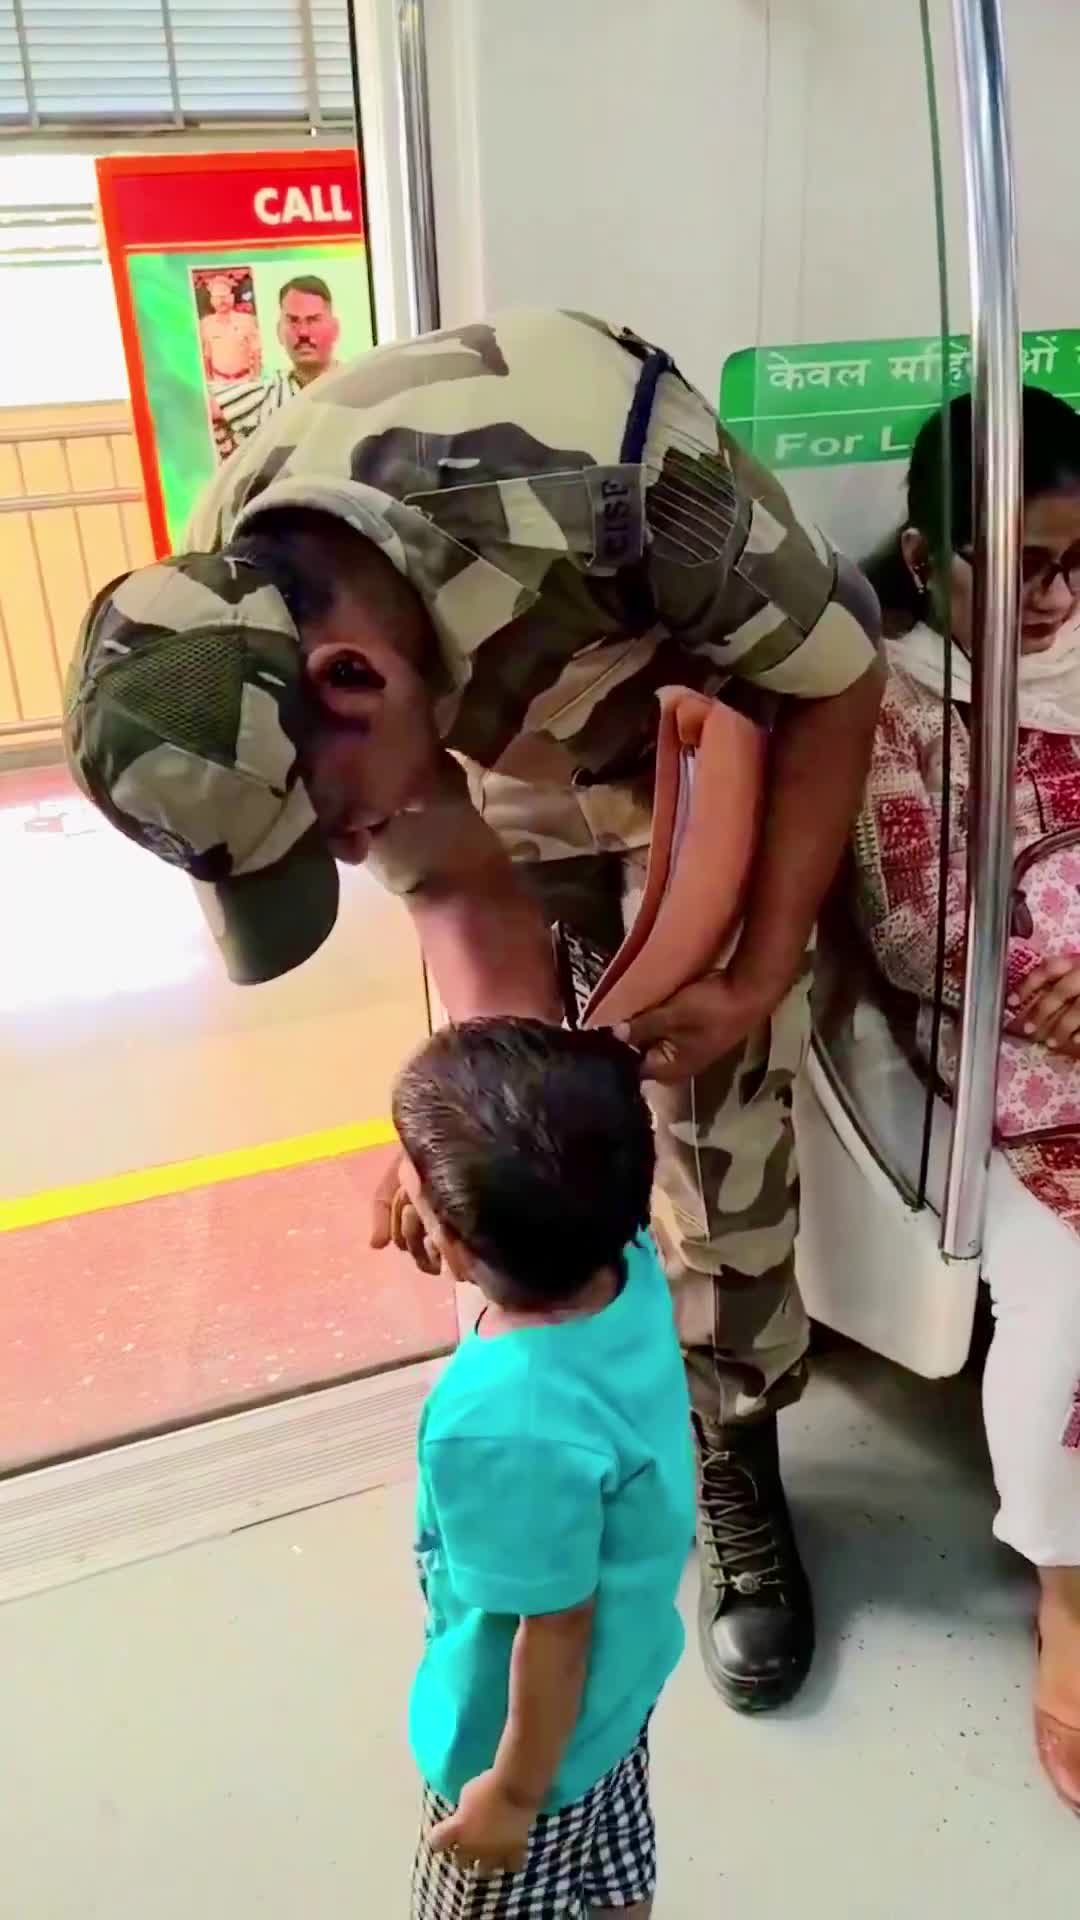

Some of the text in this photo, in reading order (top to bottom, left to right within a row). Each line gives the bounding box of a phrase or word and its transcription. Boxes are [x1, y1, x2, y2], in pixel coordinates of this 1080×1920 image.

[253, 184, 353, 226] CALL
[767, 351, 872, 391] केवल
[774, 431, 864, 460] For
